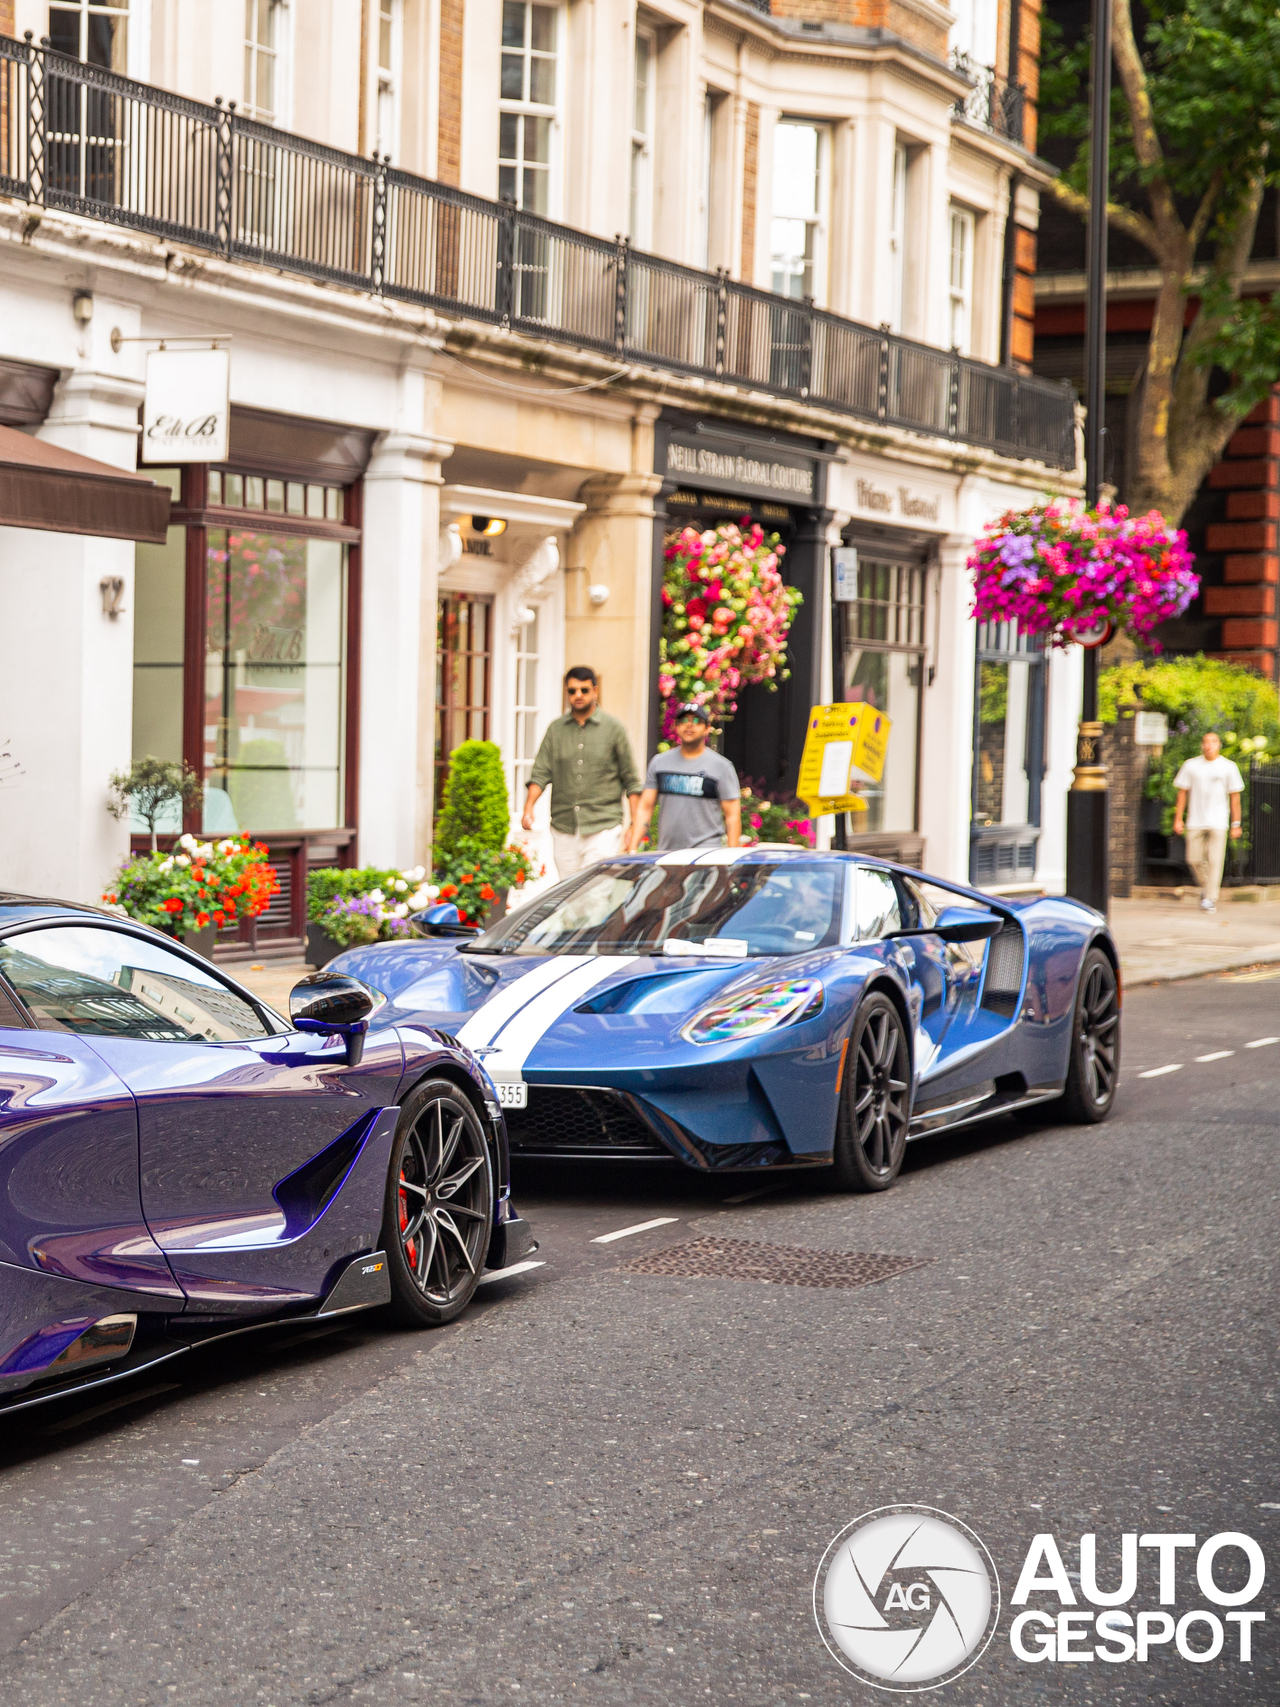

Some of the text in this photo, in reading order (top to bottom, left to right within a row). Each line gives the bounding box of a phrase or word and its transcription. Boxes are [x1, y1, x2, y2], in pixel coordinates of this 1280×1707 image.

[185, 411, 222, 438] B
[667, 443, 813, 494] NEILL STRAIN FLORAL COUTURE
